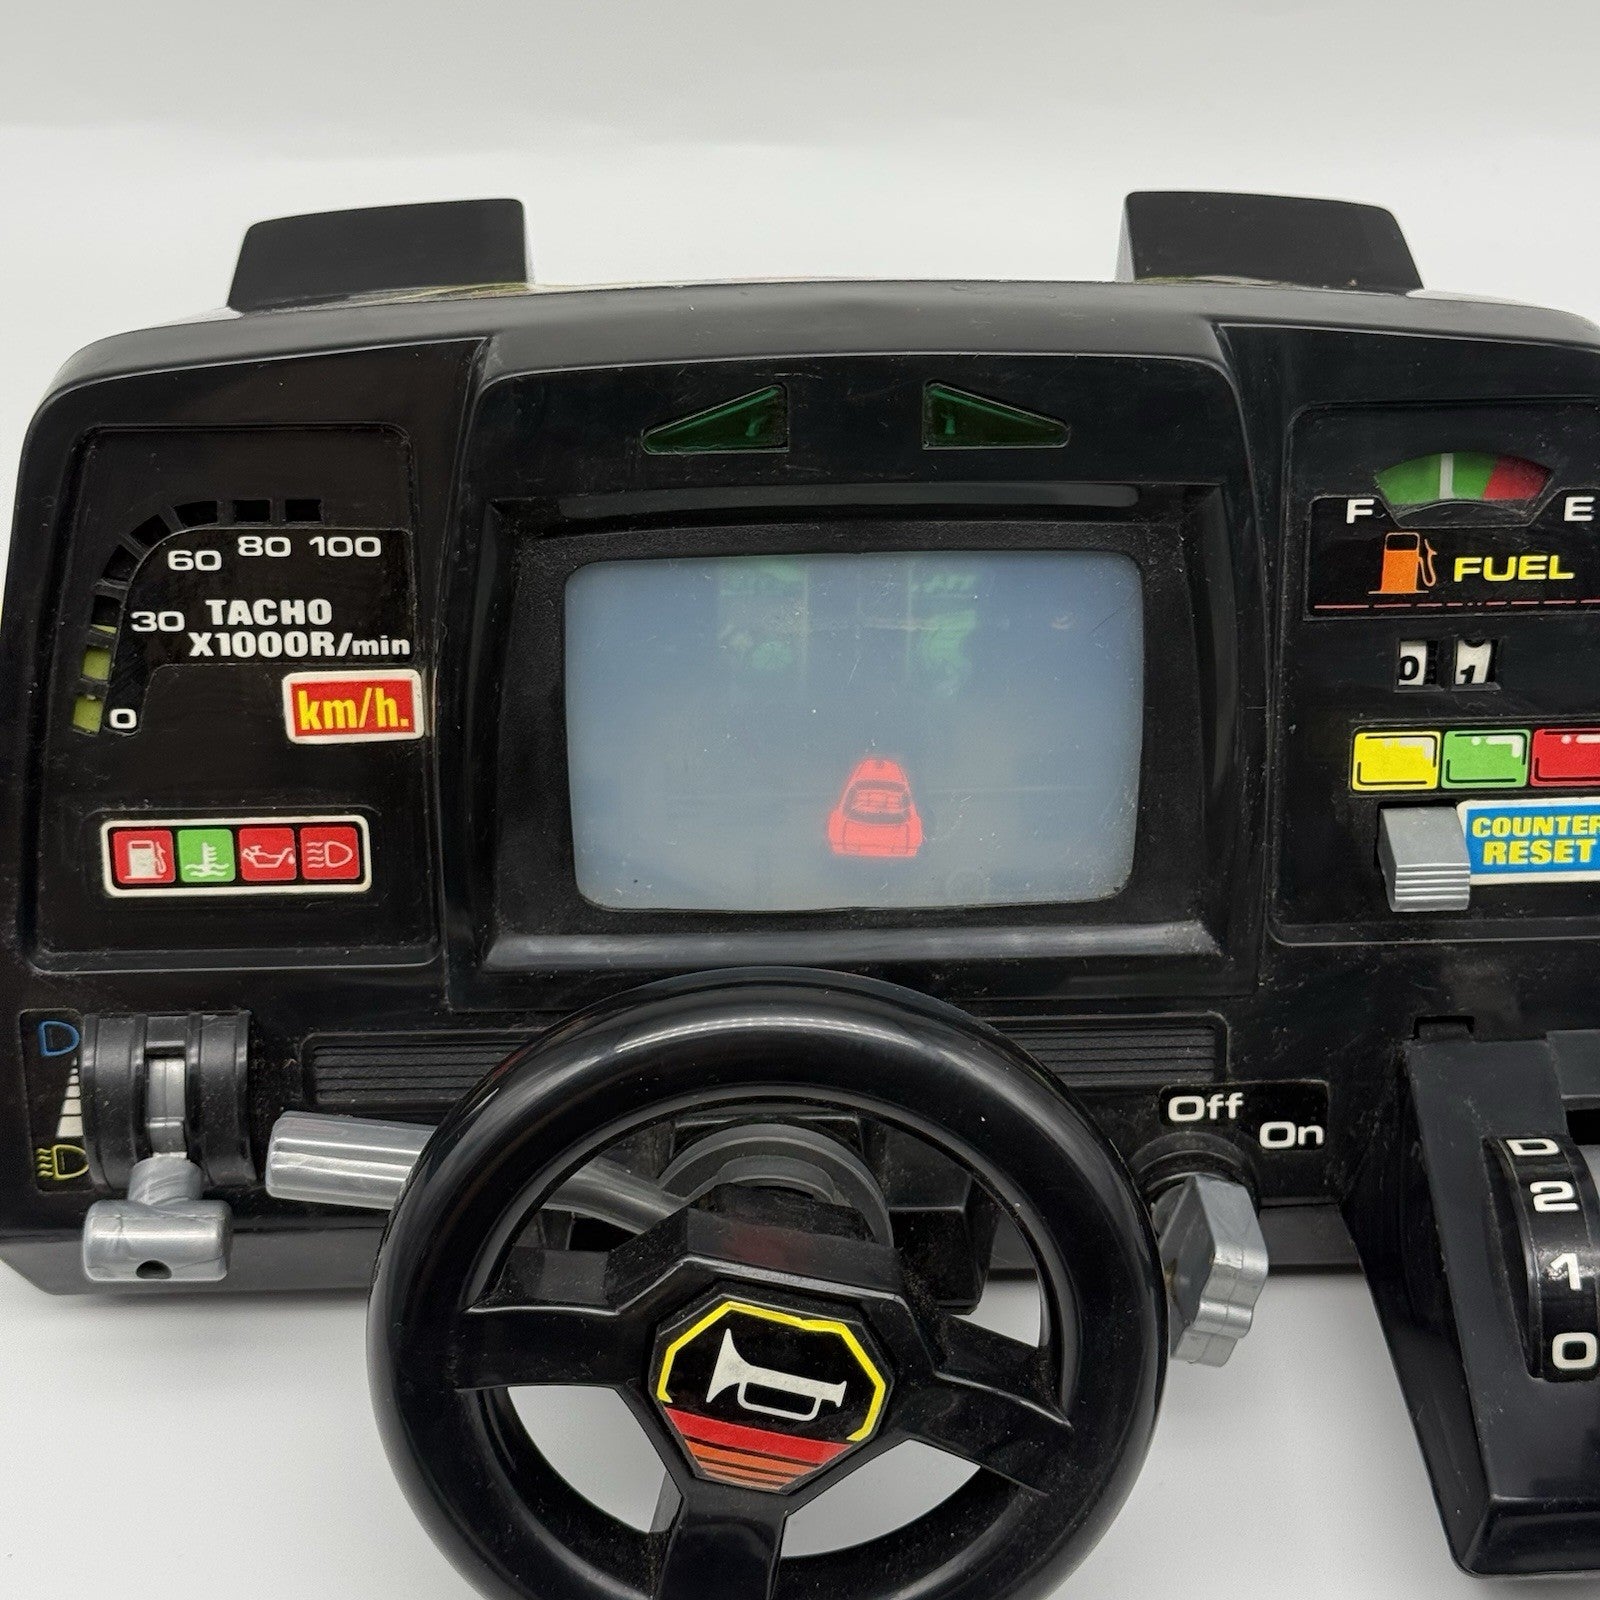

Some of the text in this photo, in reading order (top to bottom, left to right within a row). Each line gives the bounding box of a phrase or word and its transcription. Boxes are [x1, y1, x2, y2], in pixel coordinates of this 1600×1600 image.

[1346, 499, 1374, 524] F
[1564, 496, 1595, 522] E
[238, 536, 291, 557] 80
[309, 537, 381, 557] 100
[168, 550, 222, 572] 60
[1453, 555, 1575, 582] FUEL
[130, 610, 185, 632] 30
[205, 598, 333, 626] TACHO
[188, 631, 410, 658] X1000R/min
[109, 708, 136, 730] 0
[297, 688, 410, 731] km/h.
[1482, 838, 1596, 865] RESET
[1168, 1092, 1245, 1122] Off
[1259, 1121, 1325, 1149] On
[1506, 1138, 1560, 1156] D
[1530, 1181, 1580, 1213] 2
[1550, 1252, 1583, 1291] 1
[1552, 1332, 1599, 1370] 0
